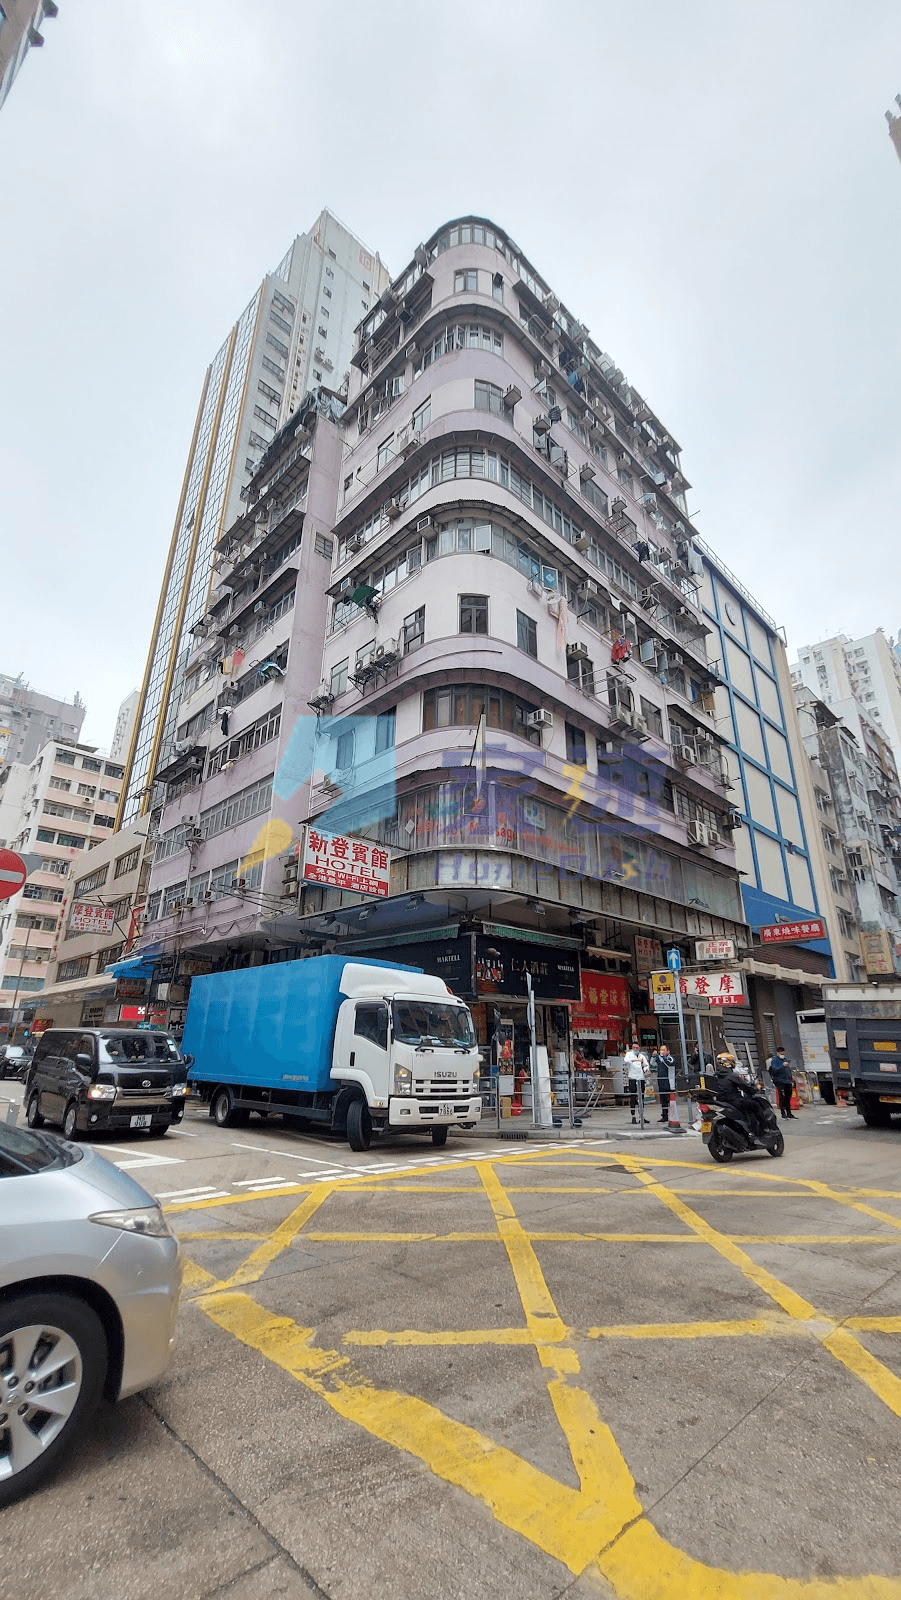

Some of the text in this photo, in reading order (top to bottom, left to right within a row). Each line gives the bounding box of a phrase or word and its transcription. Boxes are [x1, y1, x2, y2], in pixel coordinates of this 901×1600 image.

[309, 831, 389, 870] 新登賓館
[315, 855, 382, 879] HOTEL
[74, 916, 110, 926] HOTEL
[436, 954, 461, 963] MARTELL
